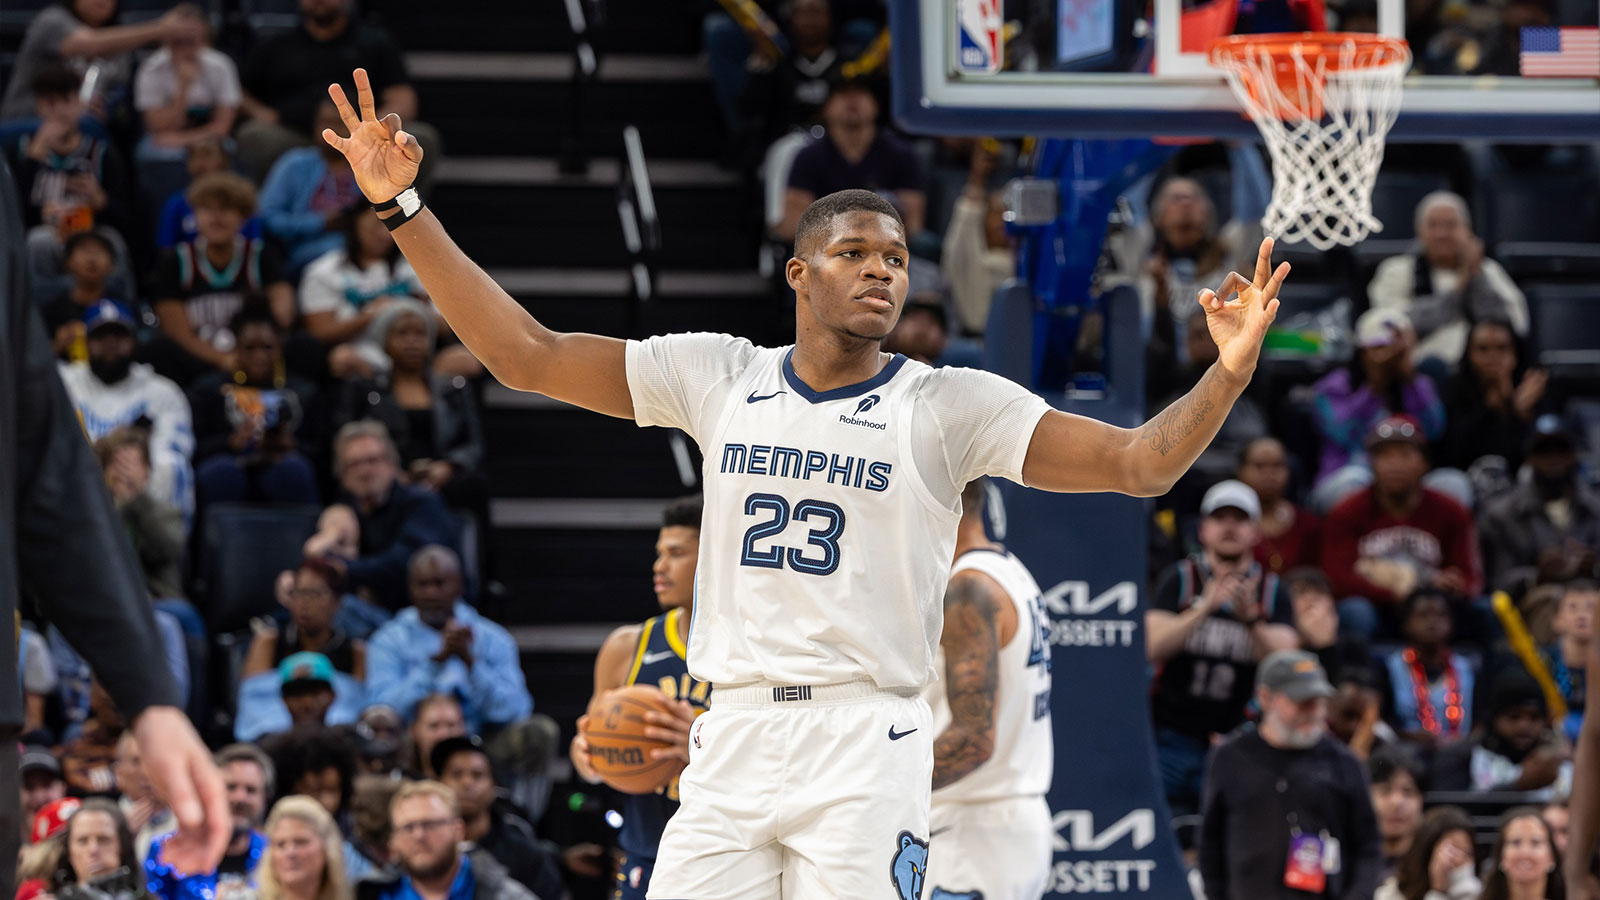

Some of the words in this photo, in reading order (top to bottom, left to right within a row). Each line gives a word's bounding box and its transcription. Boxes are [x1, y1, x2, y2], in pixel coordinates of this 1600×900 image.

[839, 414, 887, 431] Robinhood
[720, 443, 893, 493] MEMPHIS
[740, 492, 846, 576] 23
